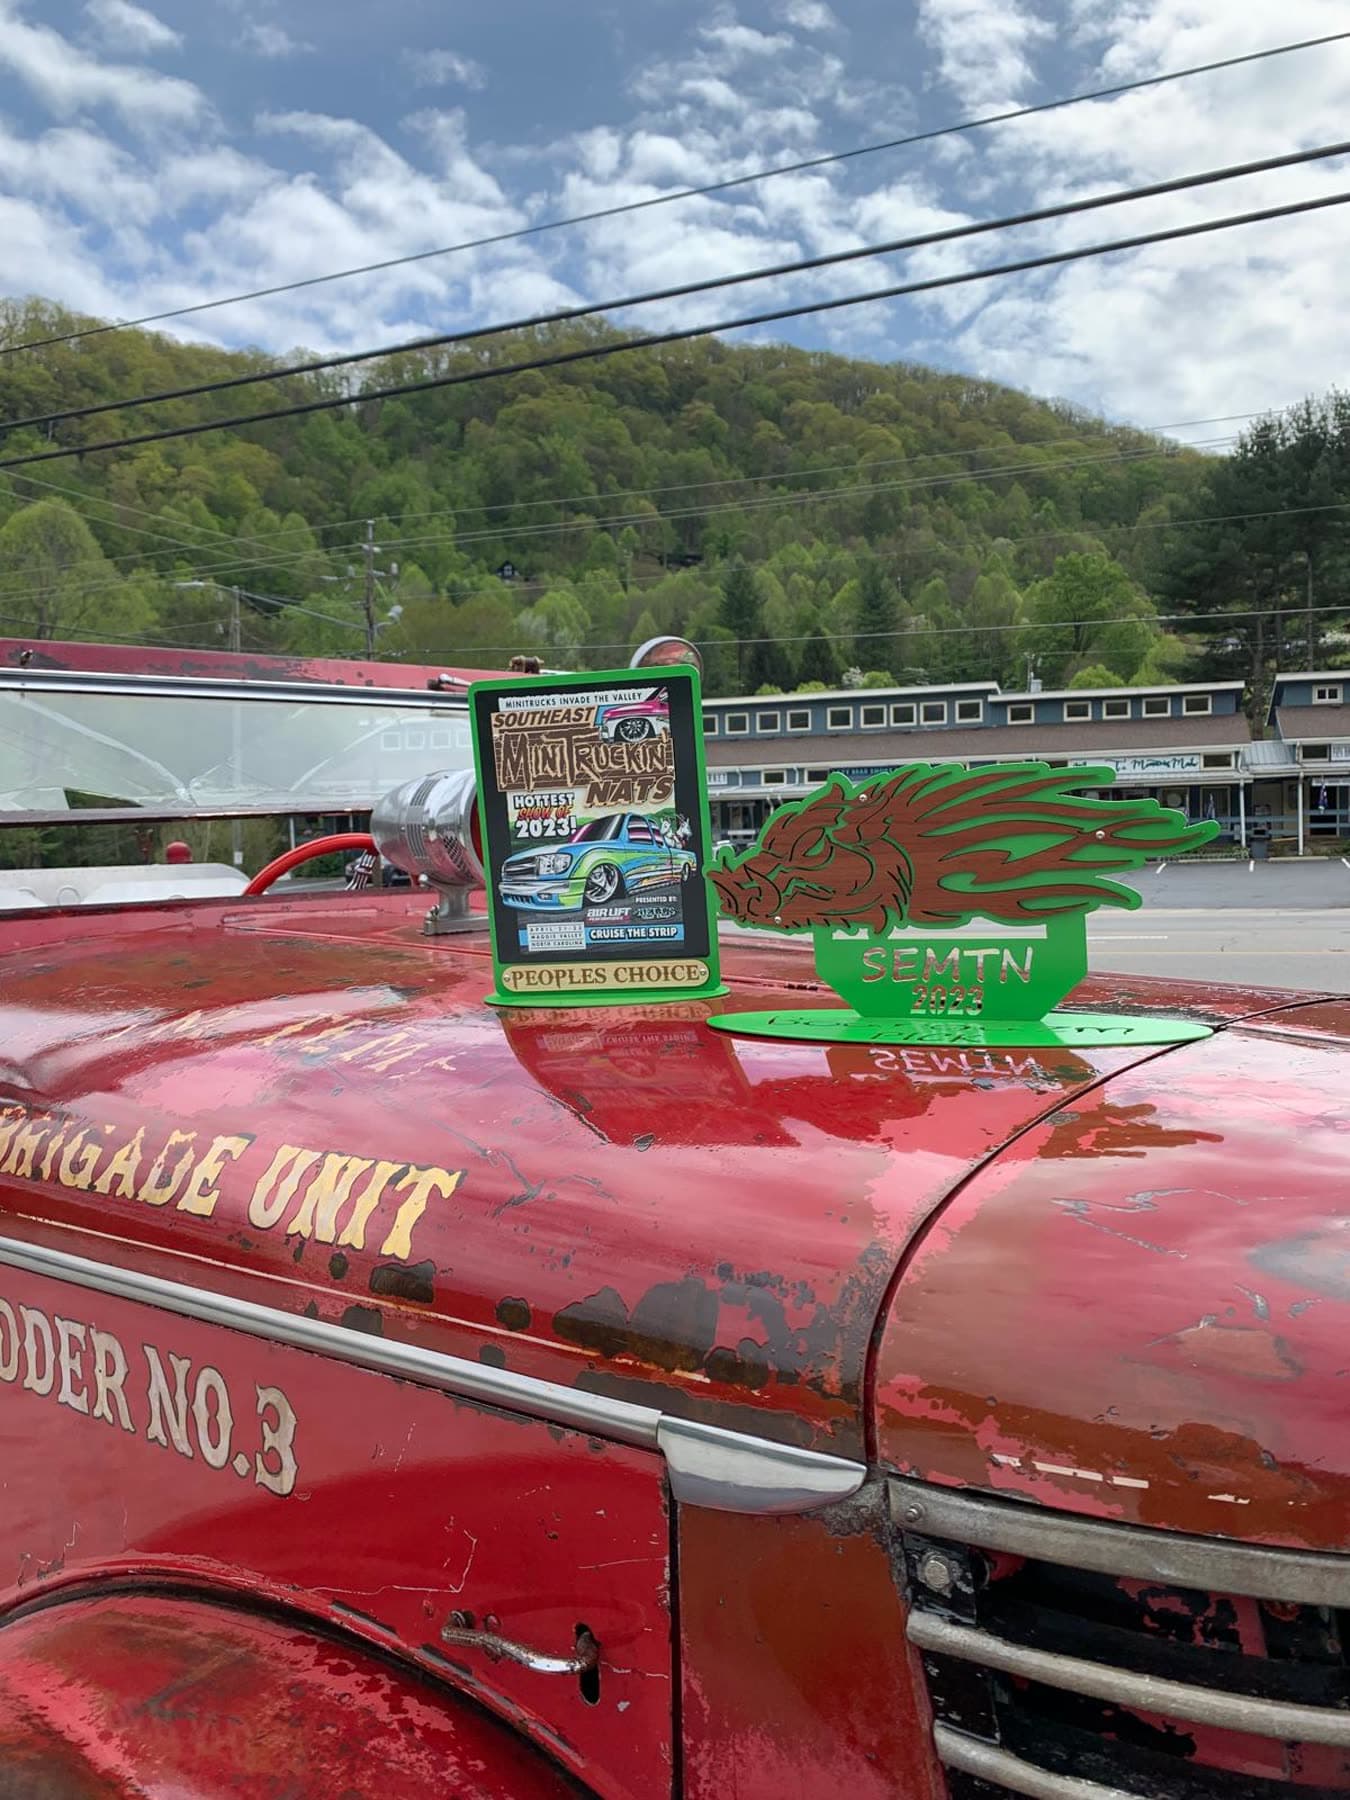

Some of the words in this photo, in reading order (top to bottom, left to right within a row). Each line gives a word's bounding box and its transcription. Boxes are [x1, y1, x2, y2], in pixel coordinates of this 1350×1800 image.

[505, 698, 556, 708] MINITRUCKS
[560, 696, 590, 705] INVADE
[594, 695, 609, 703] THE
[612, 692, 642, 702] VALLEY
[493, 706, 595, 728] SOUTHEAST
[513, 792, 575, 808] HOTTEST
[585, 775, 674, 807] NATS
[517, 807, 552, 821] SHOW
[555, 806, 572, 818] OF
[515, 816, 577, 838] 2023!
[635, 896, 667, 904] PRESENTED
[590, 928, 625, 939] CRUISE
[627, 928, 647, 939] THE
[649, 927, 677, 938] STRIP
[862, 946, 1034, 984] SEMTN
[512, 967, 607, 990] PEOPLES
[613, 964, 700, 983] CHOICE
[910, 984, 984, 1016] 2023
[248, 1143, 465, 1260] UNIT
